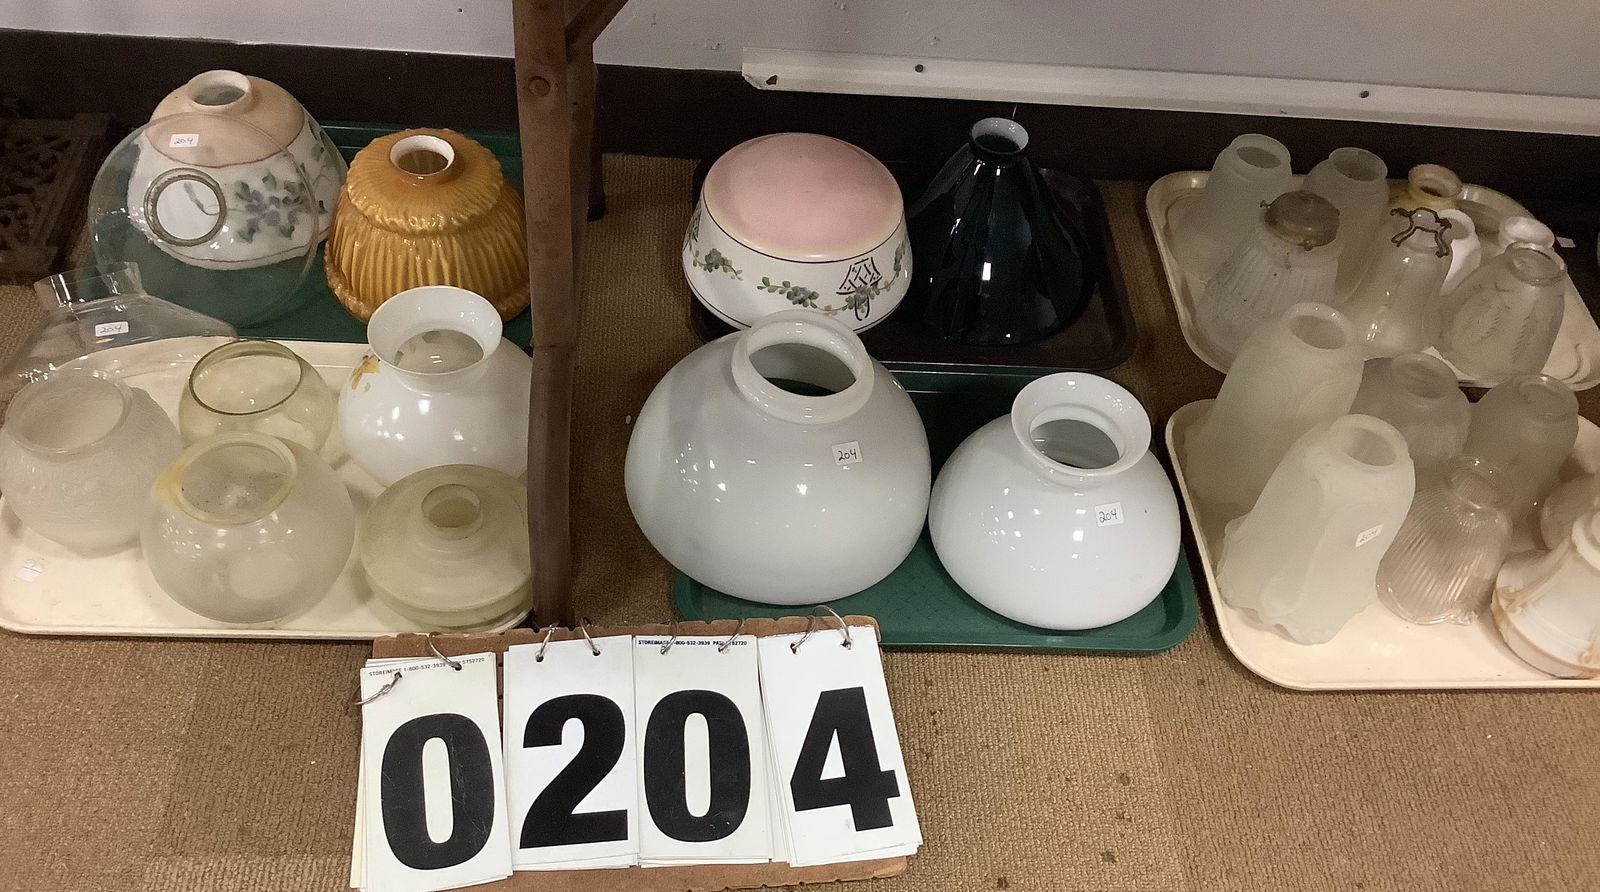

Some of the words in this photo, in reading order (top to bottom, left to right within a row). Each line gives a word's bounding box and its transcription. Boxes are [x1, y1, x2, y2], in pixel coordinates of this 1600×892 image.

[173, 137, 194, 145] 204
[100, 325, 122, 334] 204
[837, 448, 858, 462] 204
[1098, 508, 1118, 524] 204
